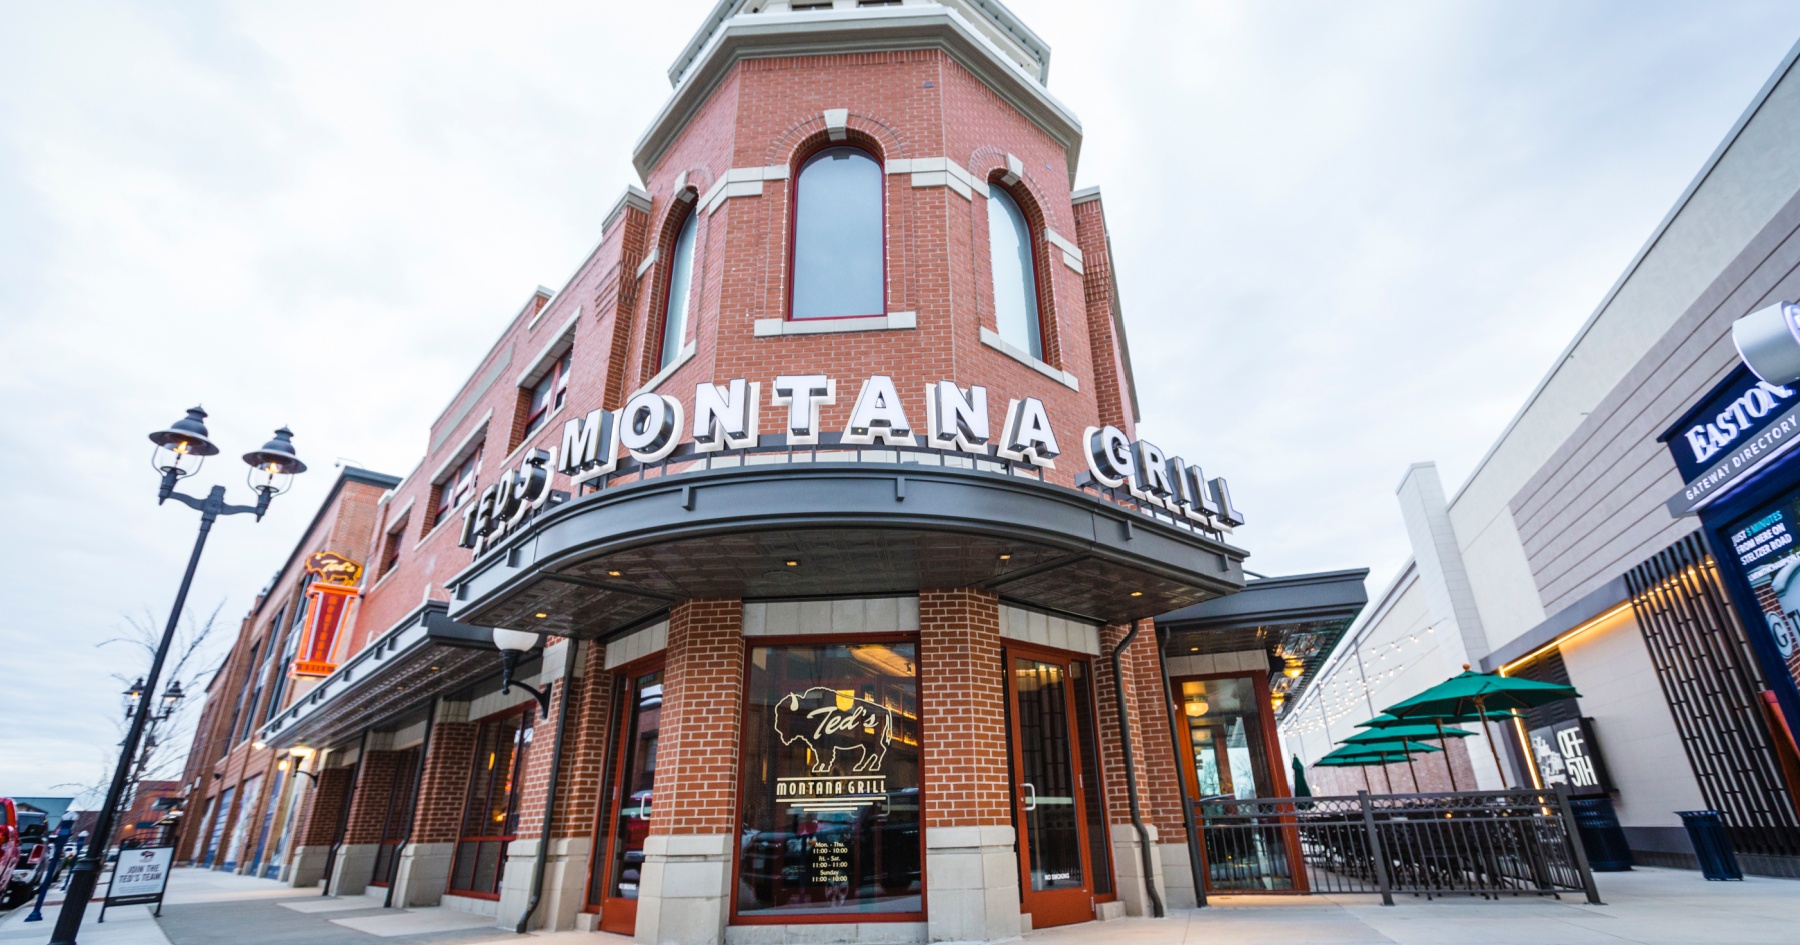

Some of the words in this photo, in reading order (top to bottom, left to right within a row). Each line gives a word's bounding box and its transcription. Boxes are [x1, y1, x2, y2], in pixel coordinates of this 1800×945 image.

[1684, 381, 1788, 463] EASTON
[557, 374, 1061, 480] MONTANA
[1085, 425, 1245, 530] GRILL
[1685, 463, 1730, 501] GATEWAY
[1732, 415, 1797, 468] DIRECTORY
[1731, 530, 1747, 547] JUST
[1750, 510, 1783, 534] MINUTES
[1735, 538, 1757, 555] FROM
[1753, 529, 1774, 545] HERE
[1771, 522, 1786, 535] ON
[1740, 544, 1772, 565] STELTZER
[1769, 533, 1793, 550] ROAD
[1772, 622, 1789, 648] G
[806, 706, 879, 739] Ted's
[1557, 727, 1584, 759] OFF
[1564, 755, 1598, 787] 5TH
[776, 781, 842, 795] MONTANA
[848, 780, 887, 794] GRILL
[127, 865, 144, 874] JOIN
[146, 864, 160, 872] THE
